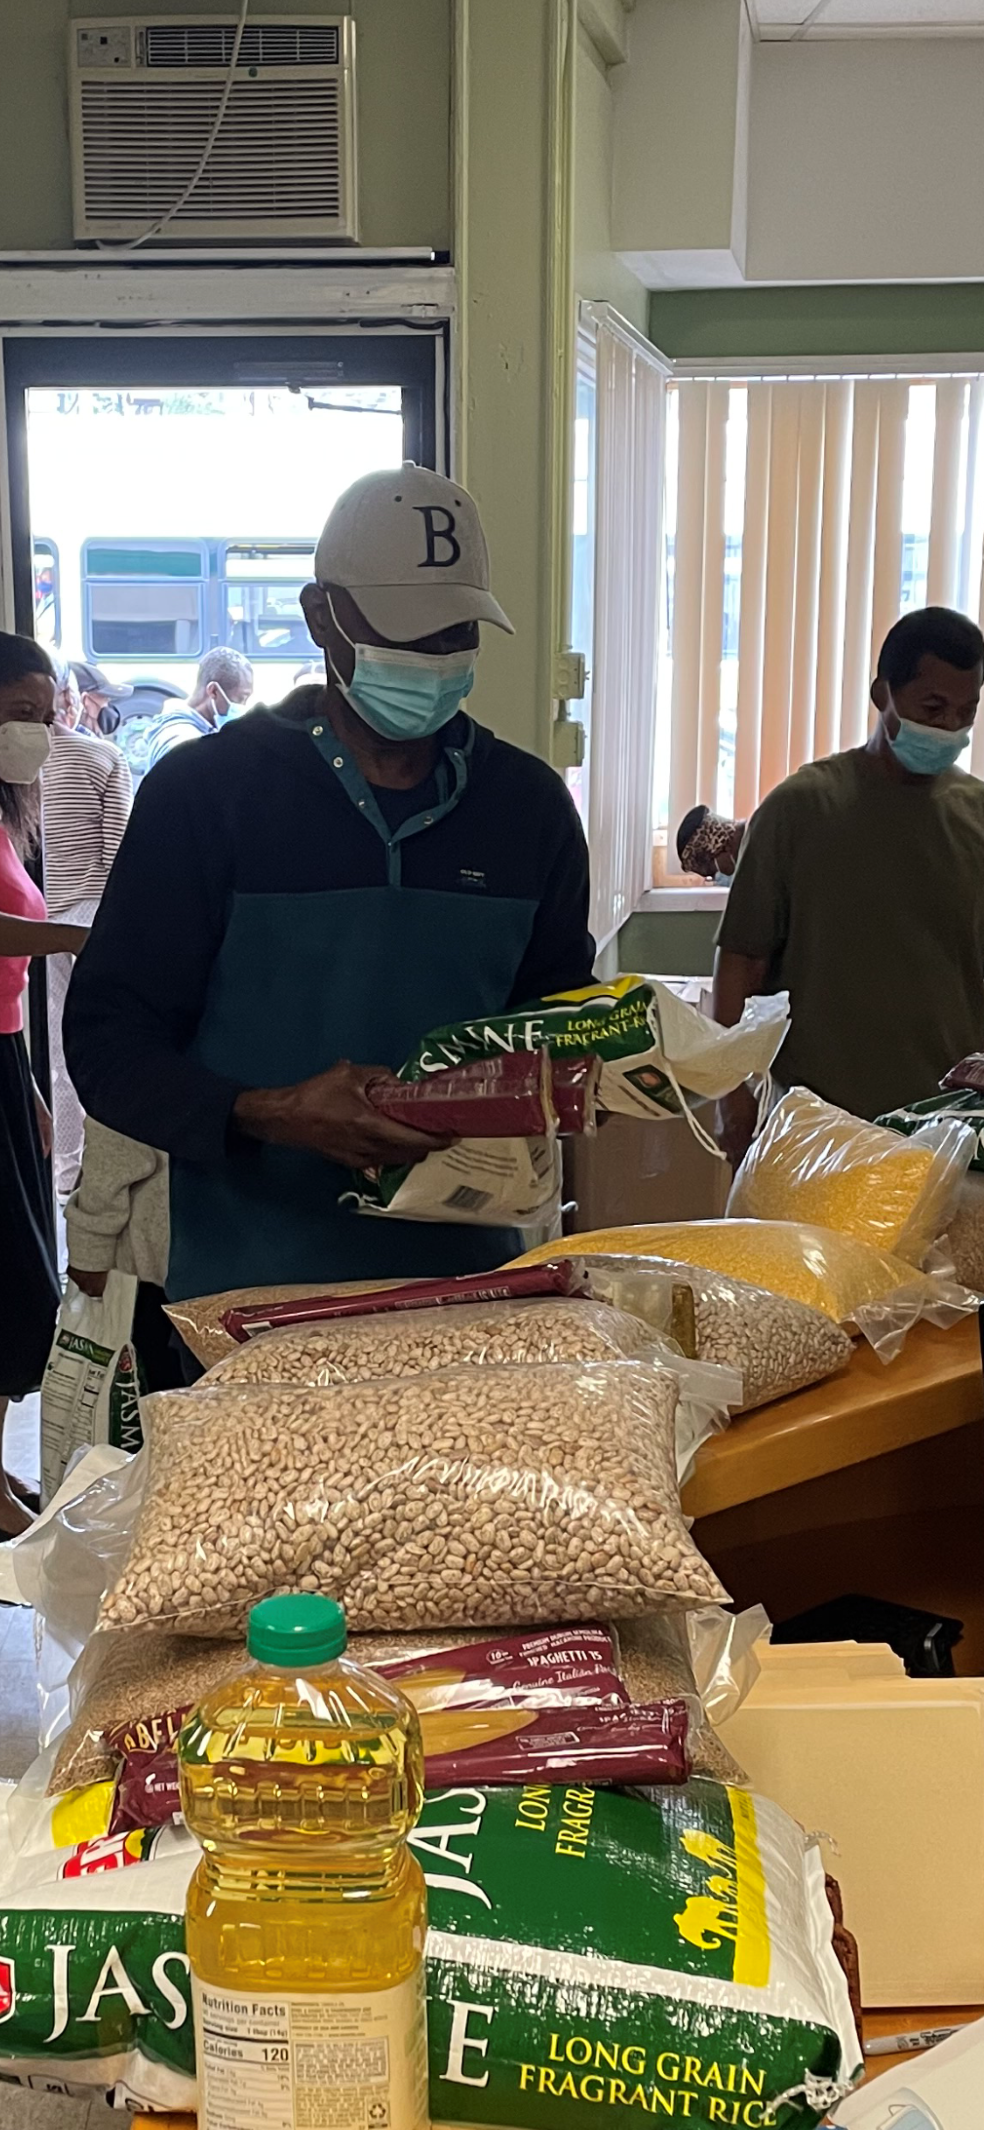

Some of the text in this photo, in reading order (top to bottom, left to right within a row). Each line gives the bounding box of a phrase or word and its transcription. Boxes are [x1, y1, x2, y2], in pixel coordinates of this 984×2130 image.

[412, 506, 461, 567] B
[202, 1992, 248, 2014] Nutrition
[252, 2003, 286, 2017] Facts
[203, 2039, 243, 2058] Calories
[262, 2047, 289, 2062] 120
[549, 2033, 767, 2096] LONG GRAIN
[519, 2063, 699, 2117] FRAGRANT
